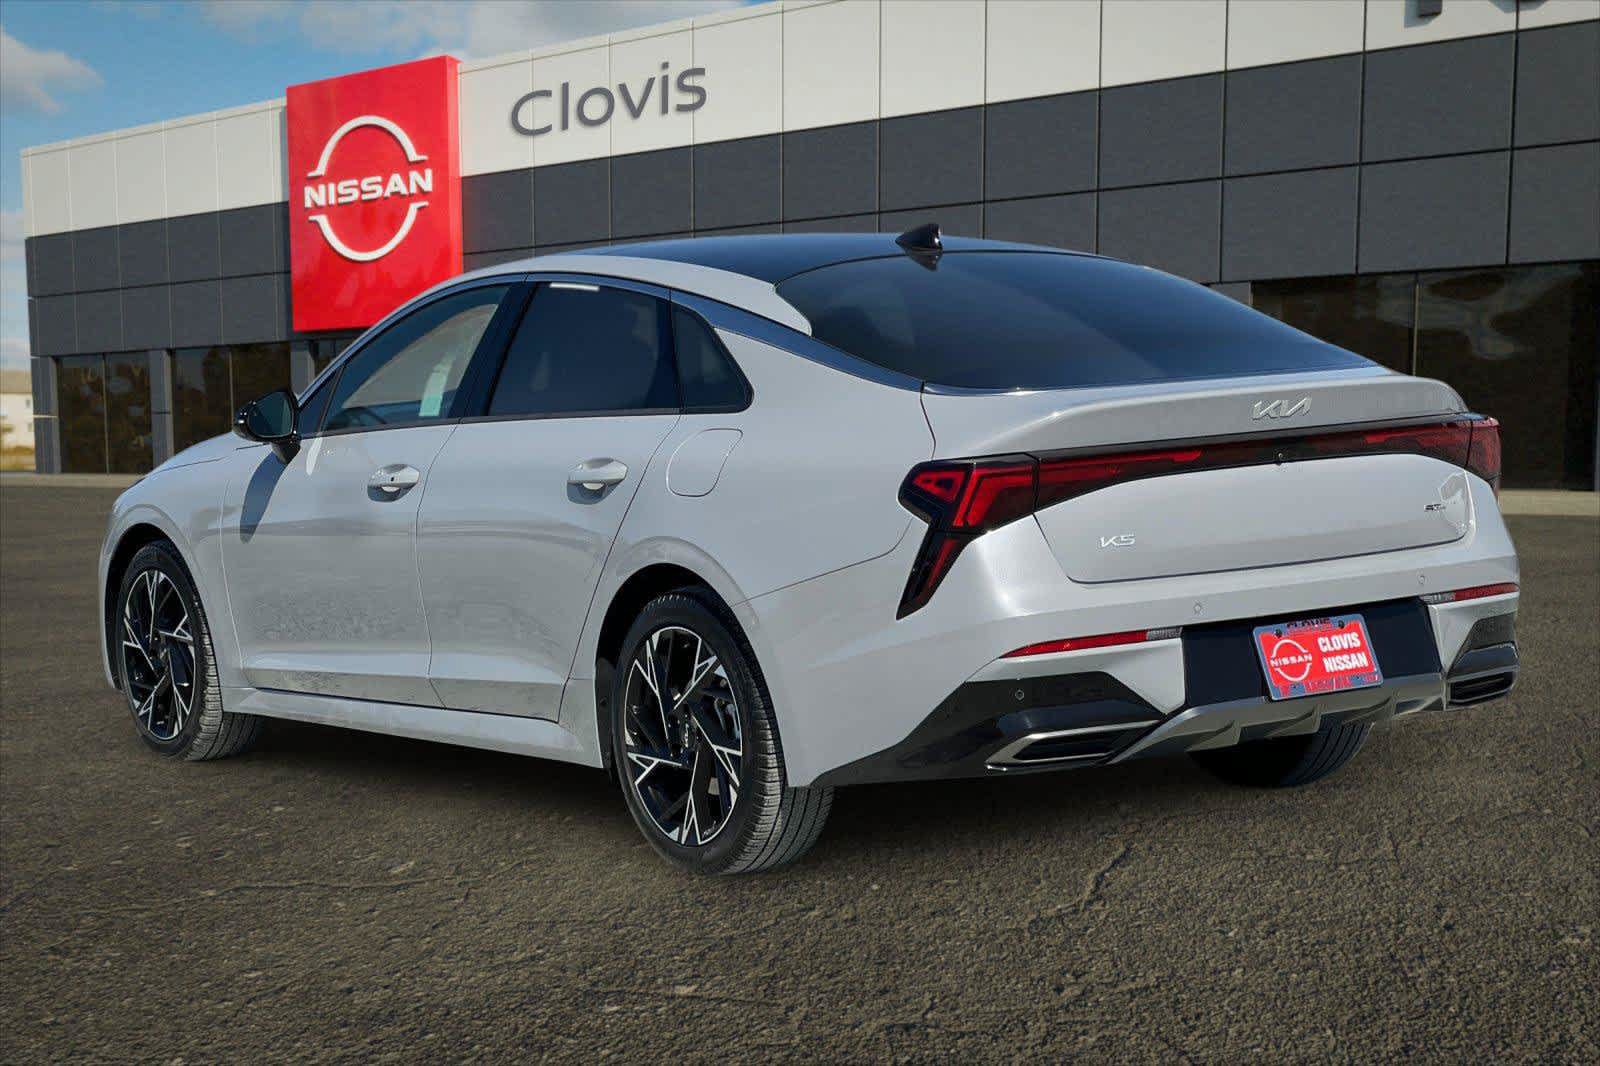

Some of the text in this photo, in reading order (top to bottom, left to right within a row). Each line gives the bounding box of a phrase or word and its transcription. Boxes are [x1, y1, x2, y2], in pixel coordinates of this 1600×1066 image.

[511, 62, 707, 137] Clovis
[304, 168, 433, 208] NISSAN
[1252, 397, 1312, 420] KIA
[1100, 535, 1136, 548] K5
[1317, 632, 1361, 652] CLOVIS
[1270, 653, 1312, 667] NISSAN
[1323, 652, 1369, 673] NISSAN
